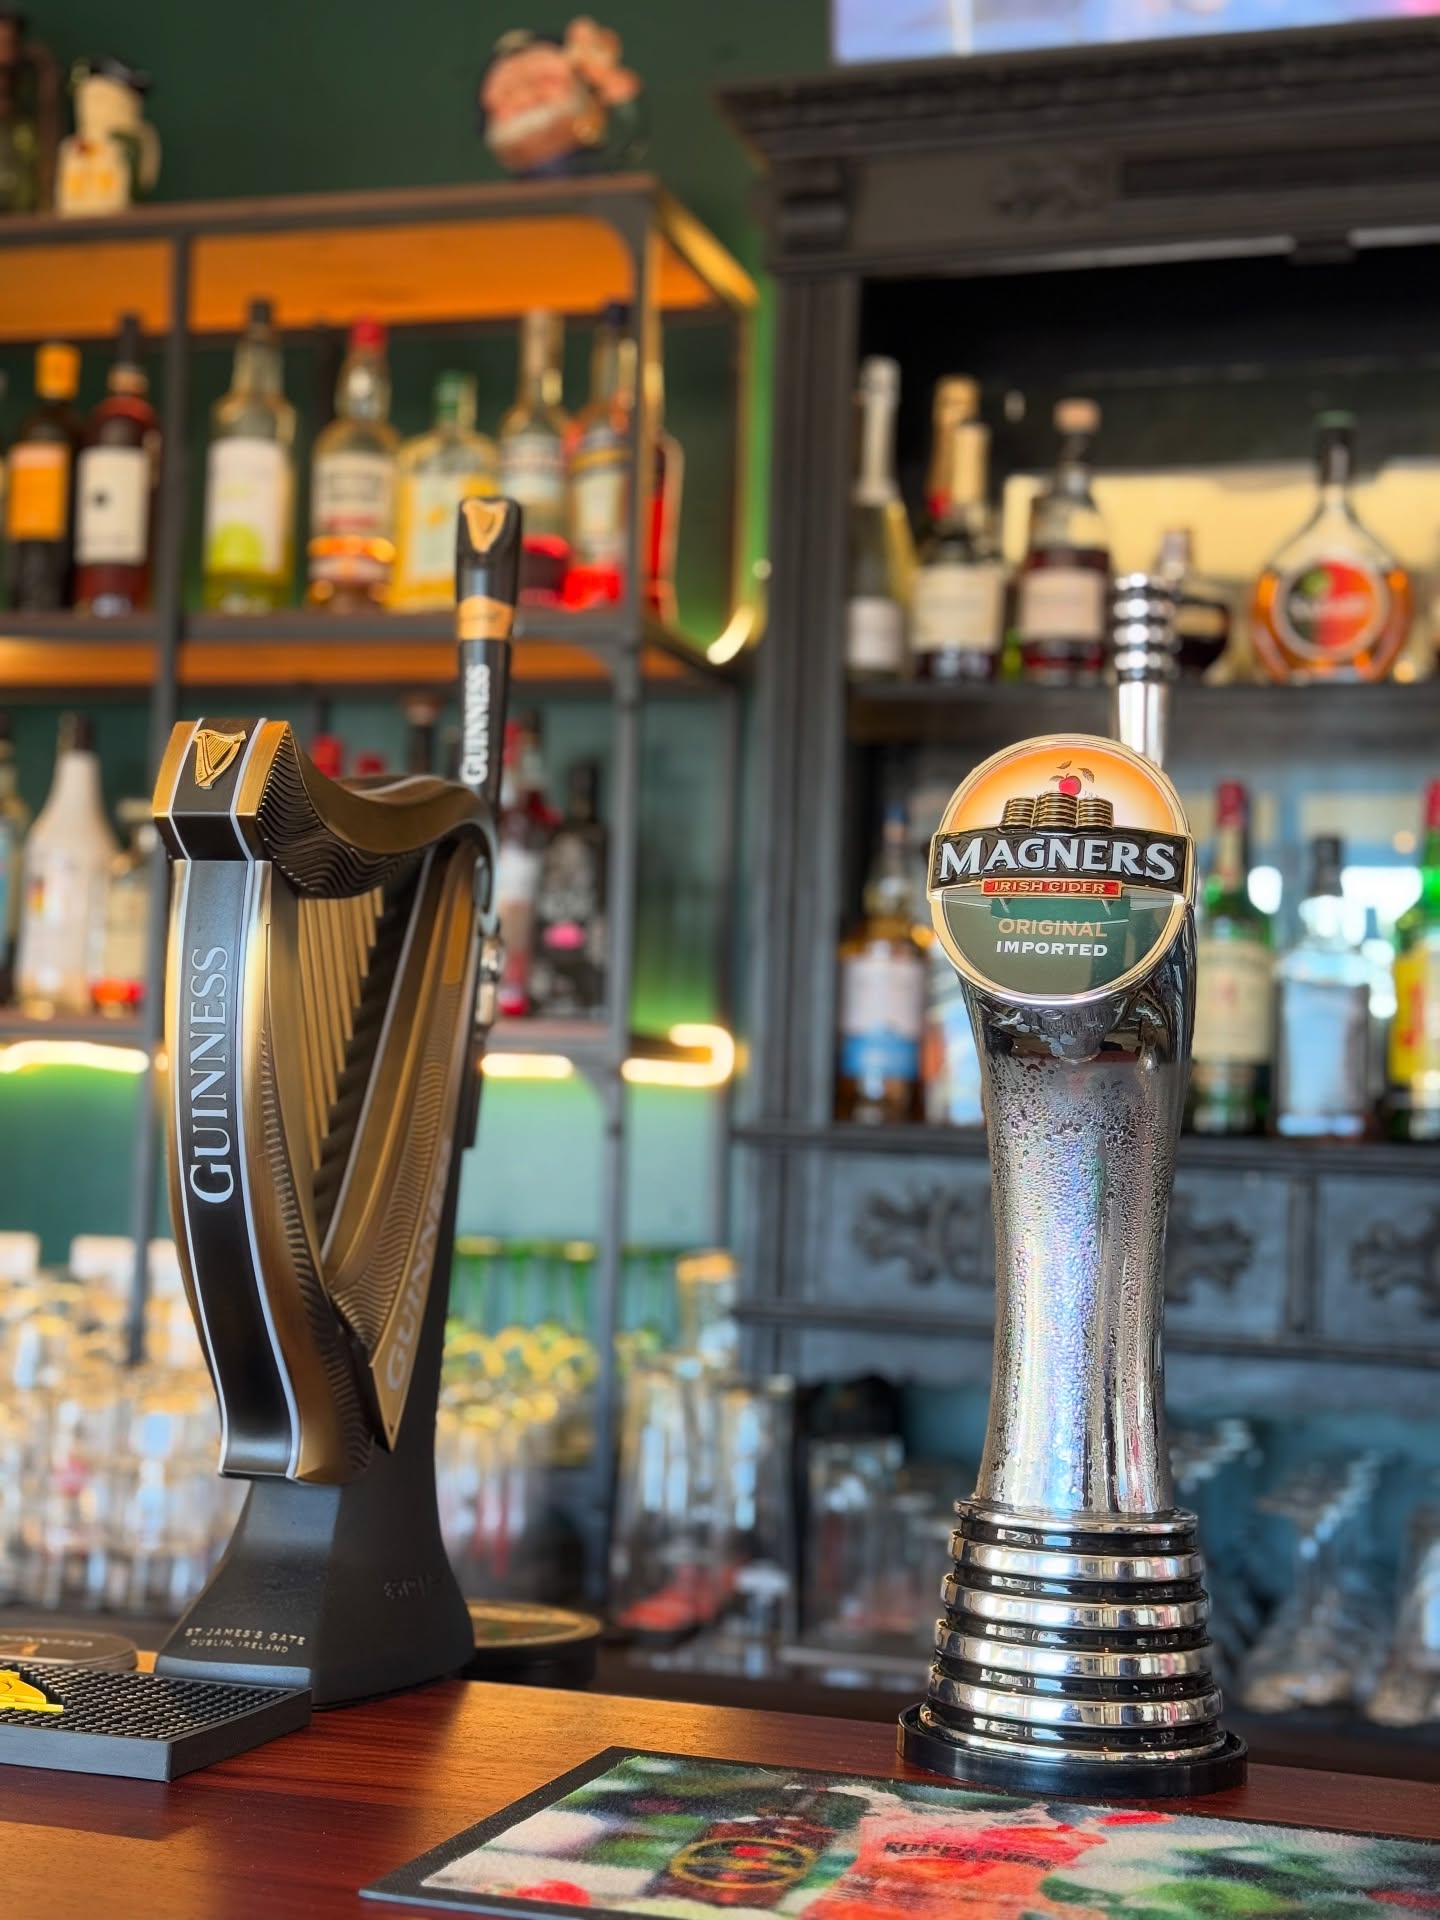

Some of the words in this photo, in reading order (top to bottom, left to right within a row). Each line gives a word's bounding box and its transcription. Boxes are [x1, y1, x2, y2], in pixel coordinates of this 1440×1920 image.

[460, 664, 491, 785] GUINNESS
[938, 837, 1175, 881] MAGNERS
[993, 881, 1043, 892] IRISH
[1049, 881, 1106, 894] CIDER
[998, 918, 1108, 937] ORIGINAL
[995, 940, 1108, 957] IMPORTED
[189, 945, 235, 1204] GUINNESS
[238, 1641, 289, 1653] IRELAND
[269, 1631, 306, 1646] GATE
[884, 1841, 1055, 1871] KOPPAR
